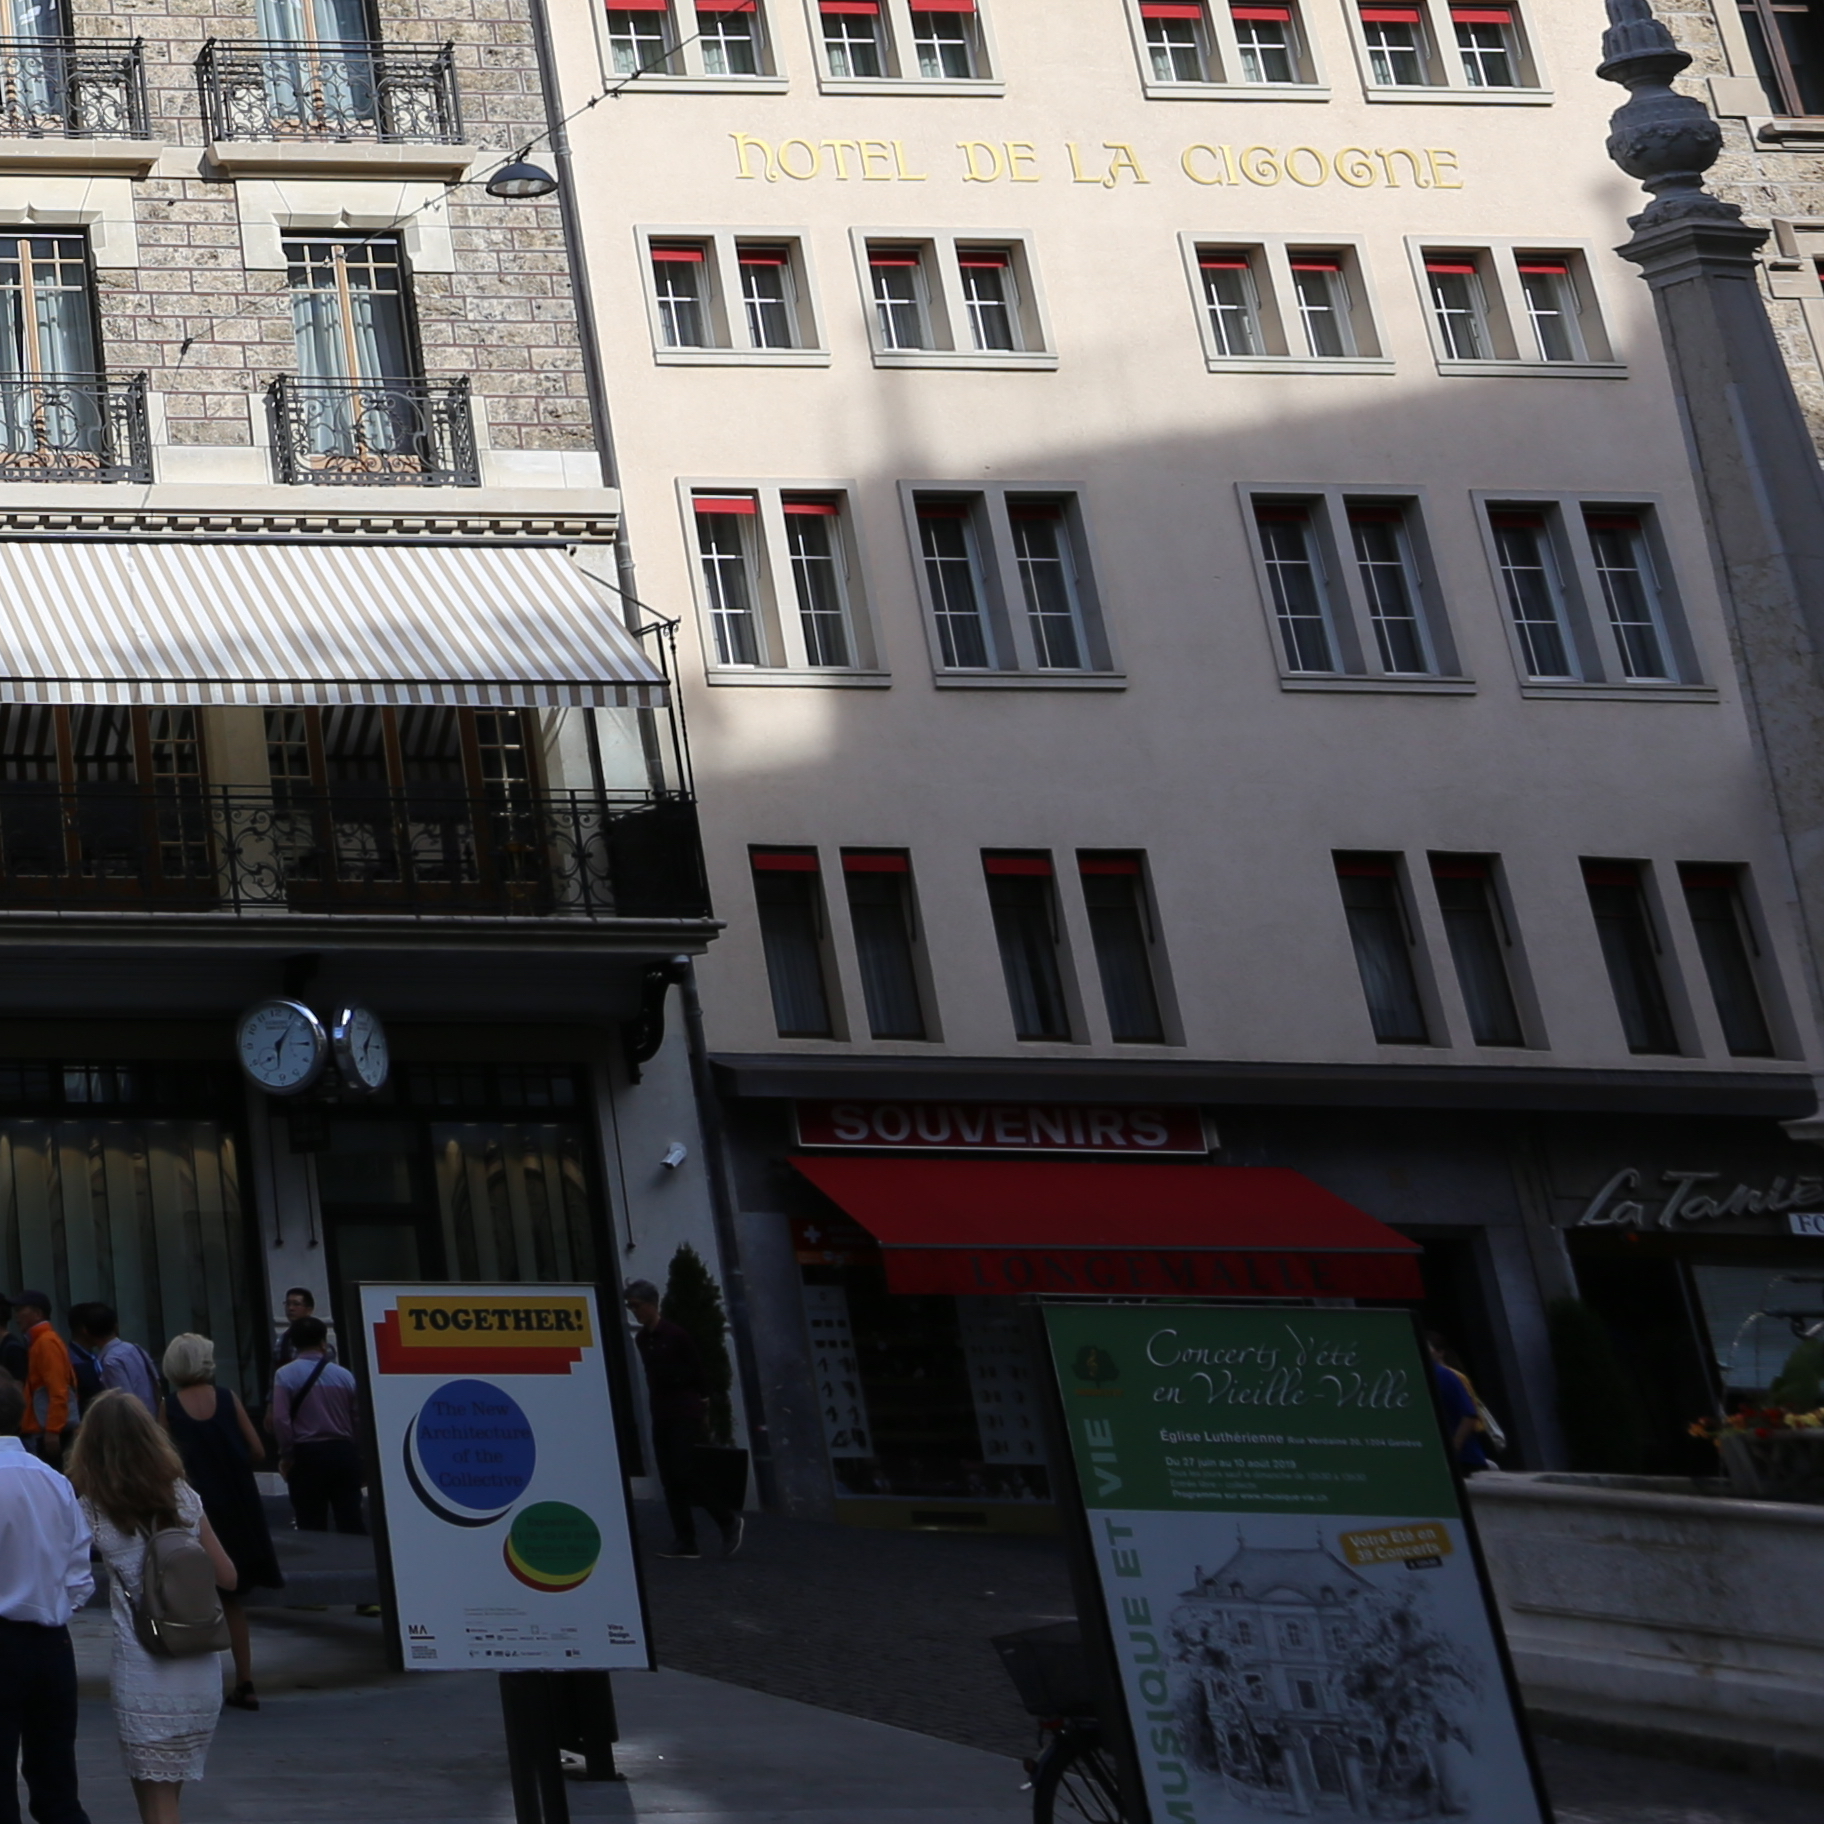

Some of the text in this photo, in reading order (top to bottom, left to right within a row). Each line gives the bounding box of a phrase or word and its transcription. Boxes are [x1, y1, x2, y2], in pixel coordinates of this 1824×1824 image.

[729, 131, 1464, 190] HOTEL DE LA CIGOGNE
[830, 1103, 1170, 1148] SOUVENIRS
[1576, 1167, 1644, 1227] La
[971, 1254, 1337, 1291] LONGEMALLE
[408, 1308, 584, 1331] TOGETHER!
[1145, 1328, 1280, 1371] Concerts
[1153, 1383, 1186, 1404] en
[433, 1401, 510, 1415] The New
[420, 1425, 532, 1440] Architecture
[1160, 1427, 1201, 1444] Église
[1204, 1431, 1285, 1445] Luthérienne
[452, 1448, 503, 1463] of the
[1083, 1419, 1124, 1498] VIE
[1165, 1456, 1180, 1466] Du
[1182, 1457, 1194, 1466] 27
[1198, 1458, 1217, 1468] juin
[439, 1472, 523, 1487] Collective
[1104, 1518, 1143, 1578] ET
[1349, 1534, 1388, 1547] Votre
[1416, 1529, 1437, 1540] en
[1375, 1542, 1442, 1559] Concerts
